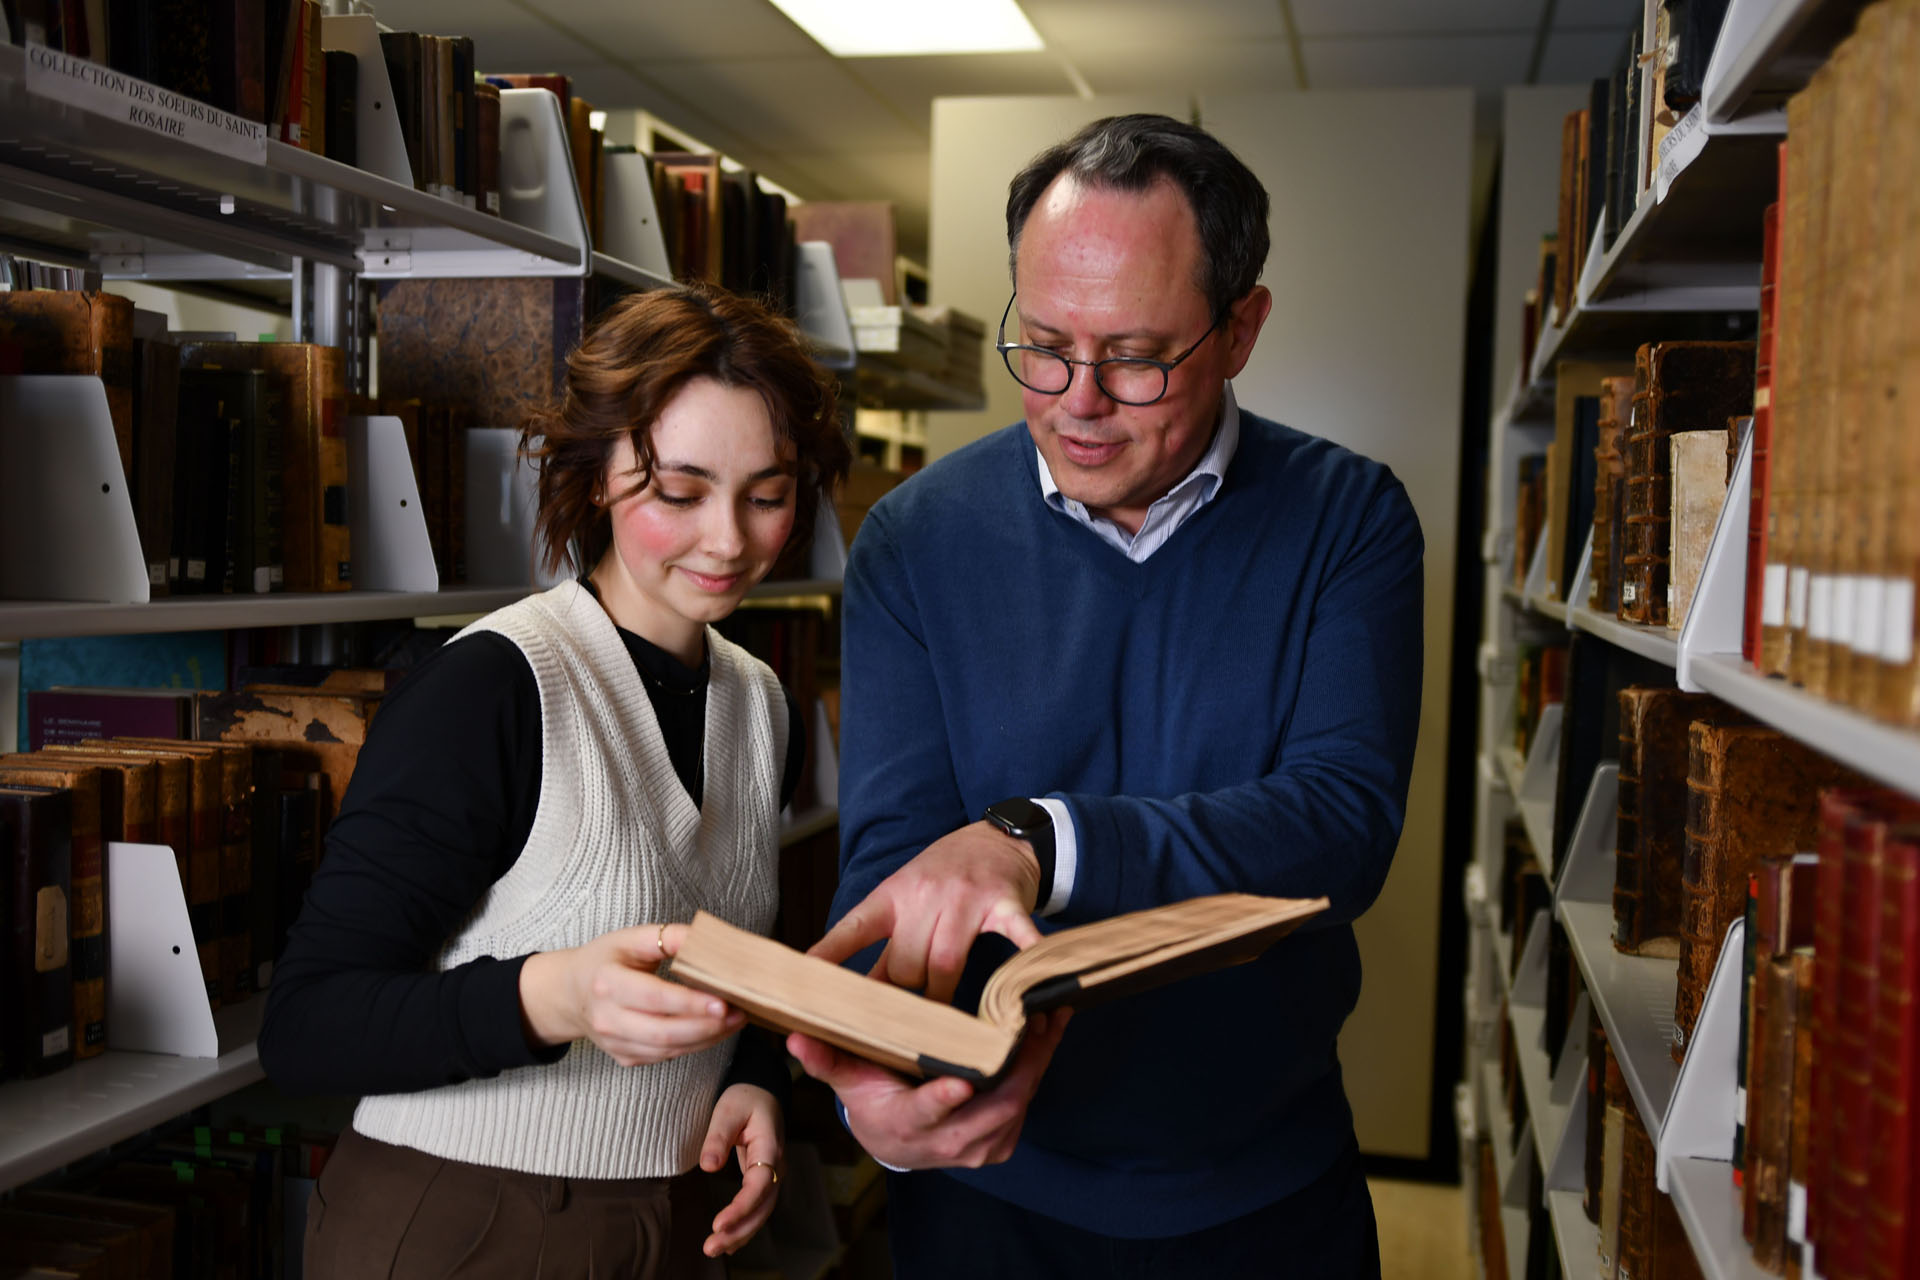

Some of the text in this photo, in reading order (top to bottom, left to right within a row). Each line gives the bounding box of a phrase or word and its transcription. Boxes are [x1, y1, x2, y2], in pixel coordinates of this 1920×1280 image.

[30, 48, 124, 93] COLLECTION
[129, 82, 154, 102] DES
[207, 109, 223, 128] DU
[225, 116, 263, 139] SAINT-
[130, 105, 185, 137] ROSAIRE
